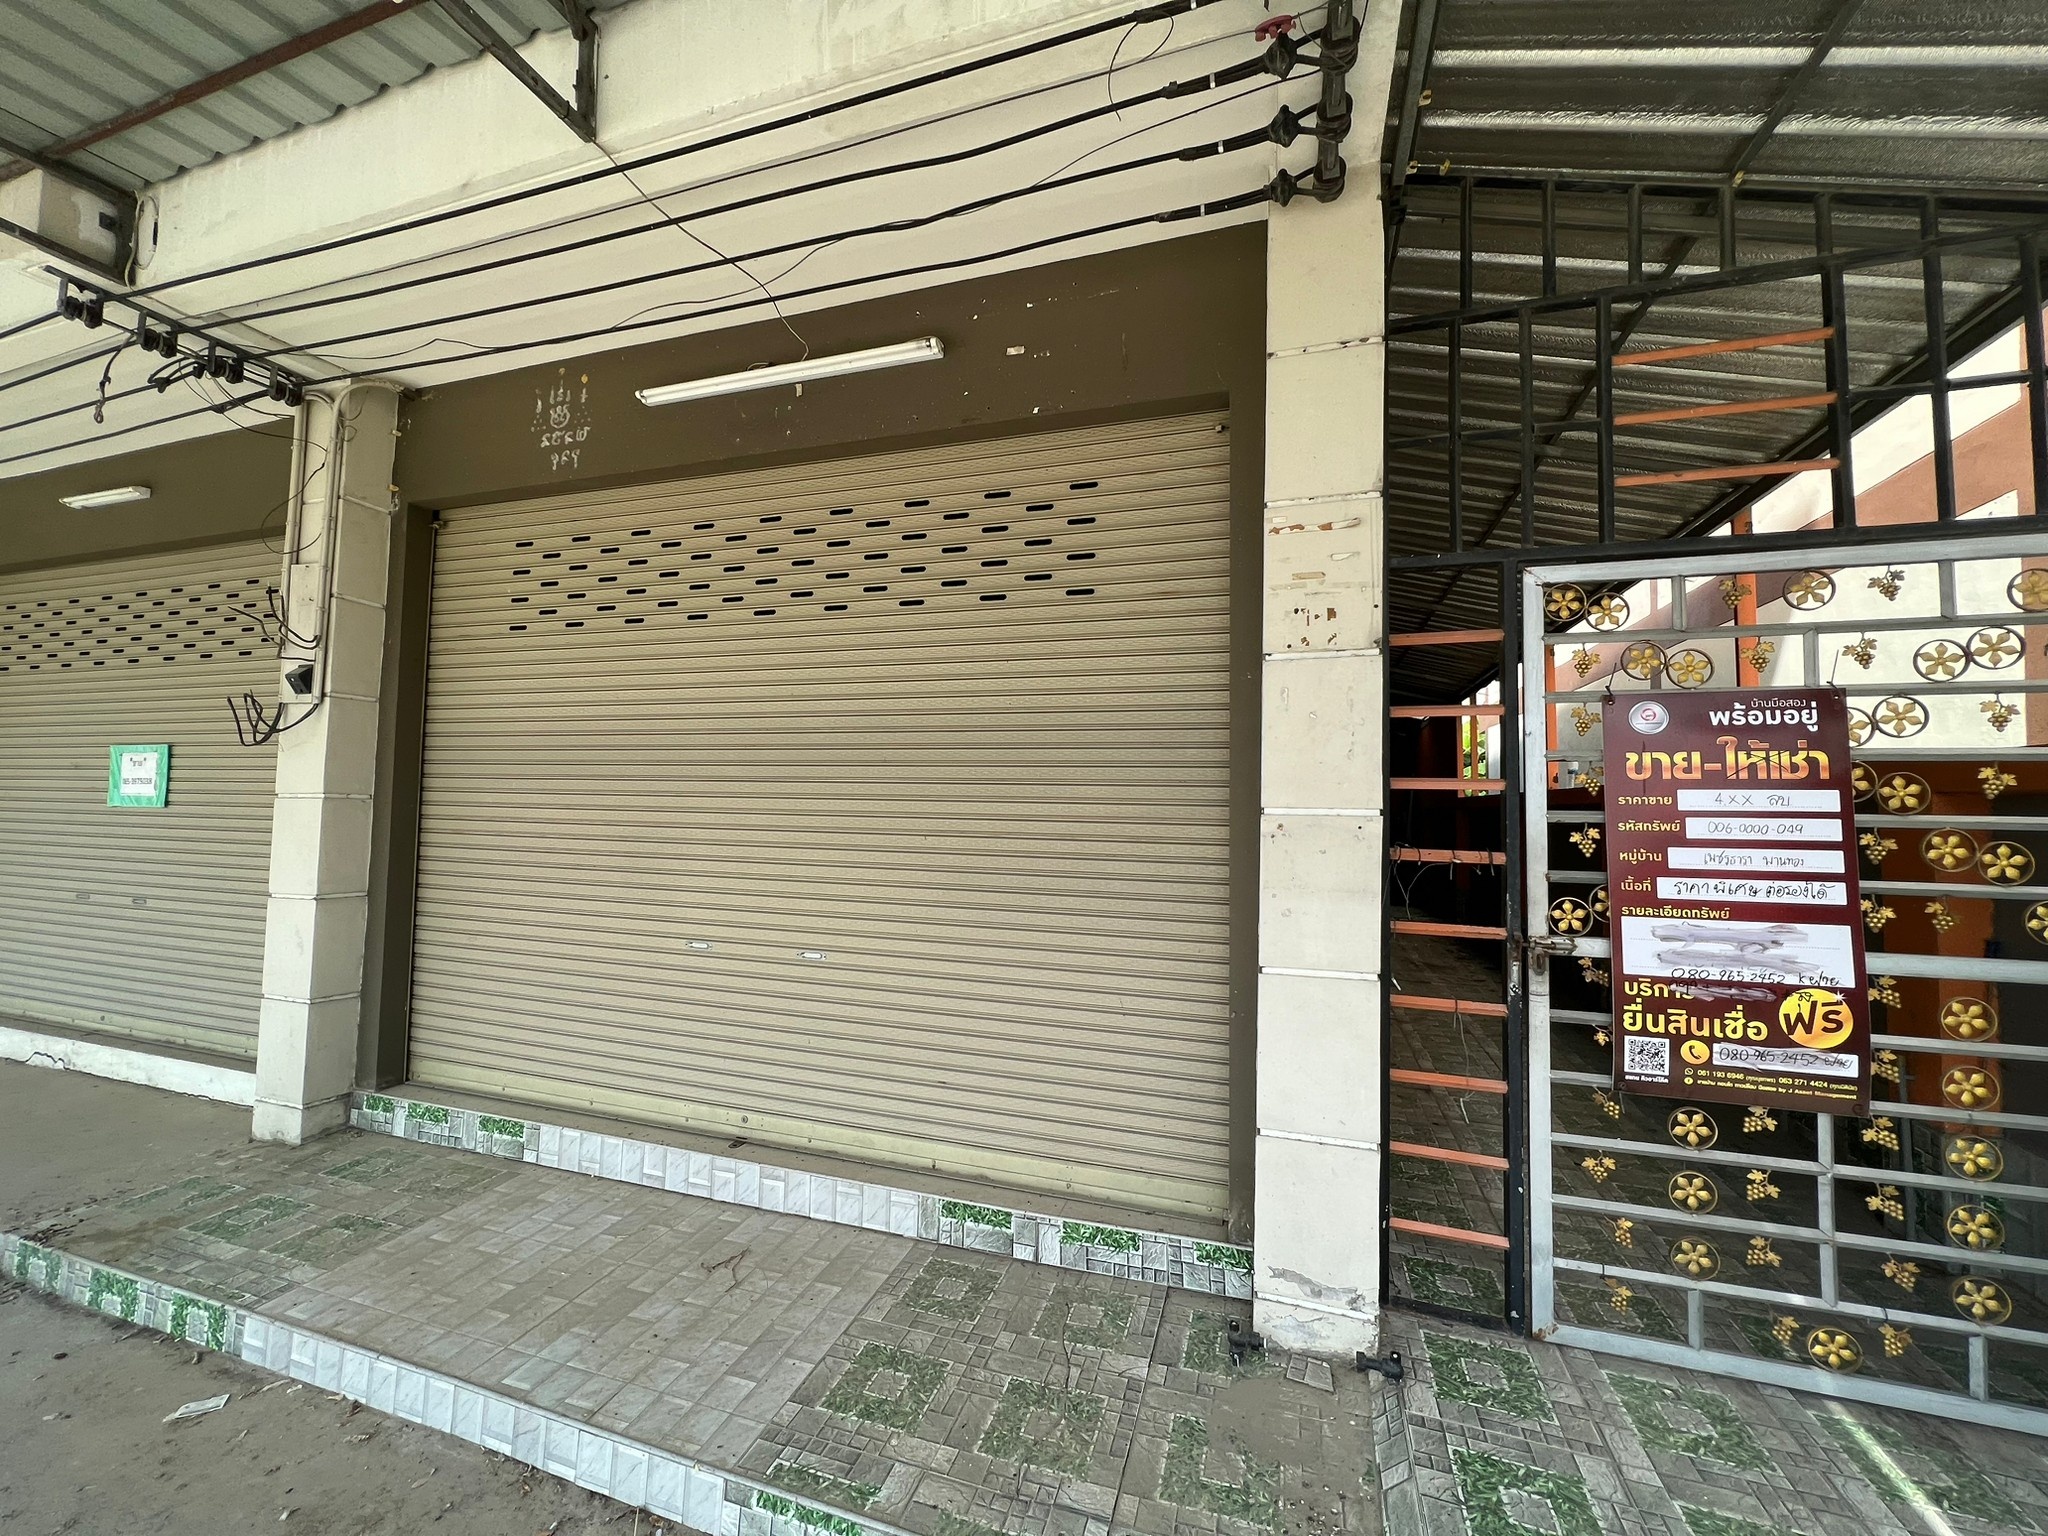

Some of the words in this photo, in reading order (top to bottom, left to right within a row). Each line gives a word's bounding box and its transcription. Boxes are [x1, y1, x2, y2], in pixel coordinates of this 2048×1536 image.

[1750, 697, 1807, 708] บ้านมือสอง
[1709, 701, 1819, 732] พร้อมอยู่
[1618, 795, 1673, 806] ราคาขาย
[1617, 819, 1681, 833] รหัสทรัพย์
[1707, 821, 1804, 835] 006-0000-049
[1619, 848, 1662, 865] หมู่บ้าน
[1620, 875, 1652, 892] เนื้อที่
[1621, 905, 1730, 920] รายละเอียดทรัพย์
[1622, 998, 1768, 1042] ยื่นสินเชื่อ
[1783, 999, 1844, 1036] ฟรี
[1794, 1078, 1807, 1086] 271
